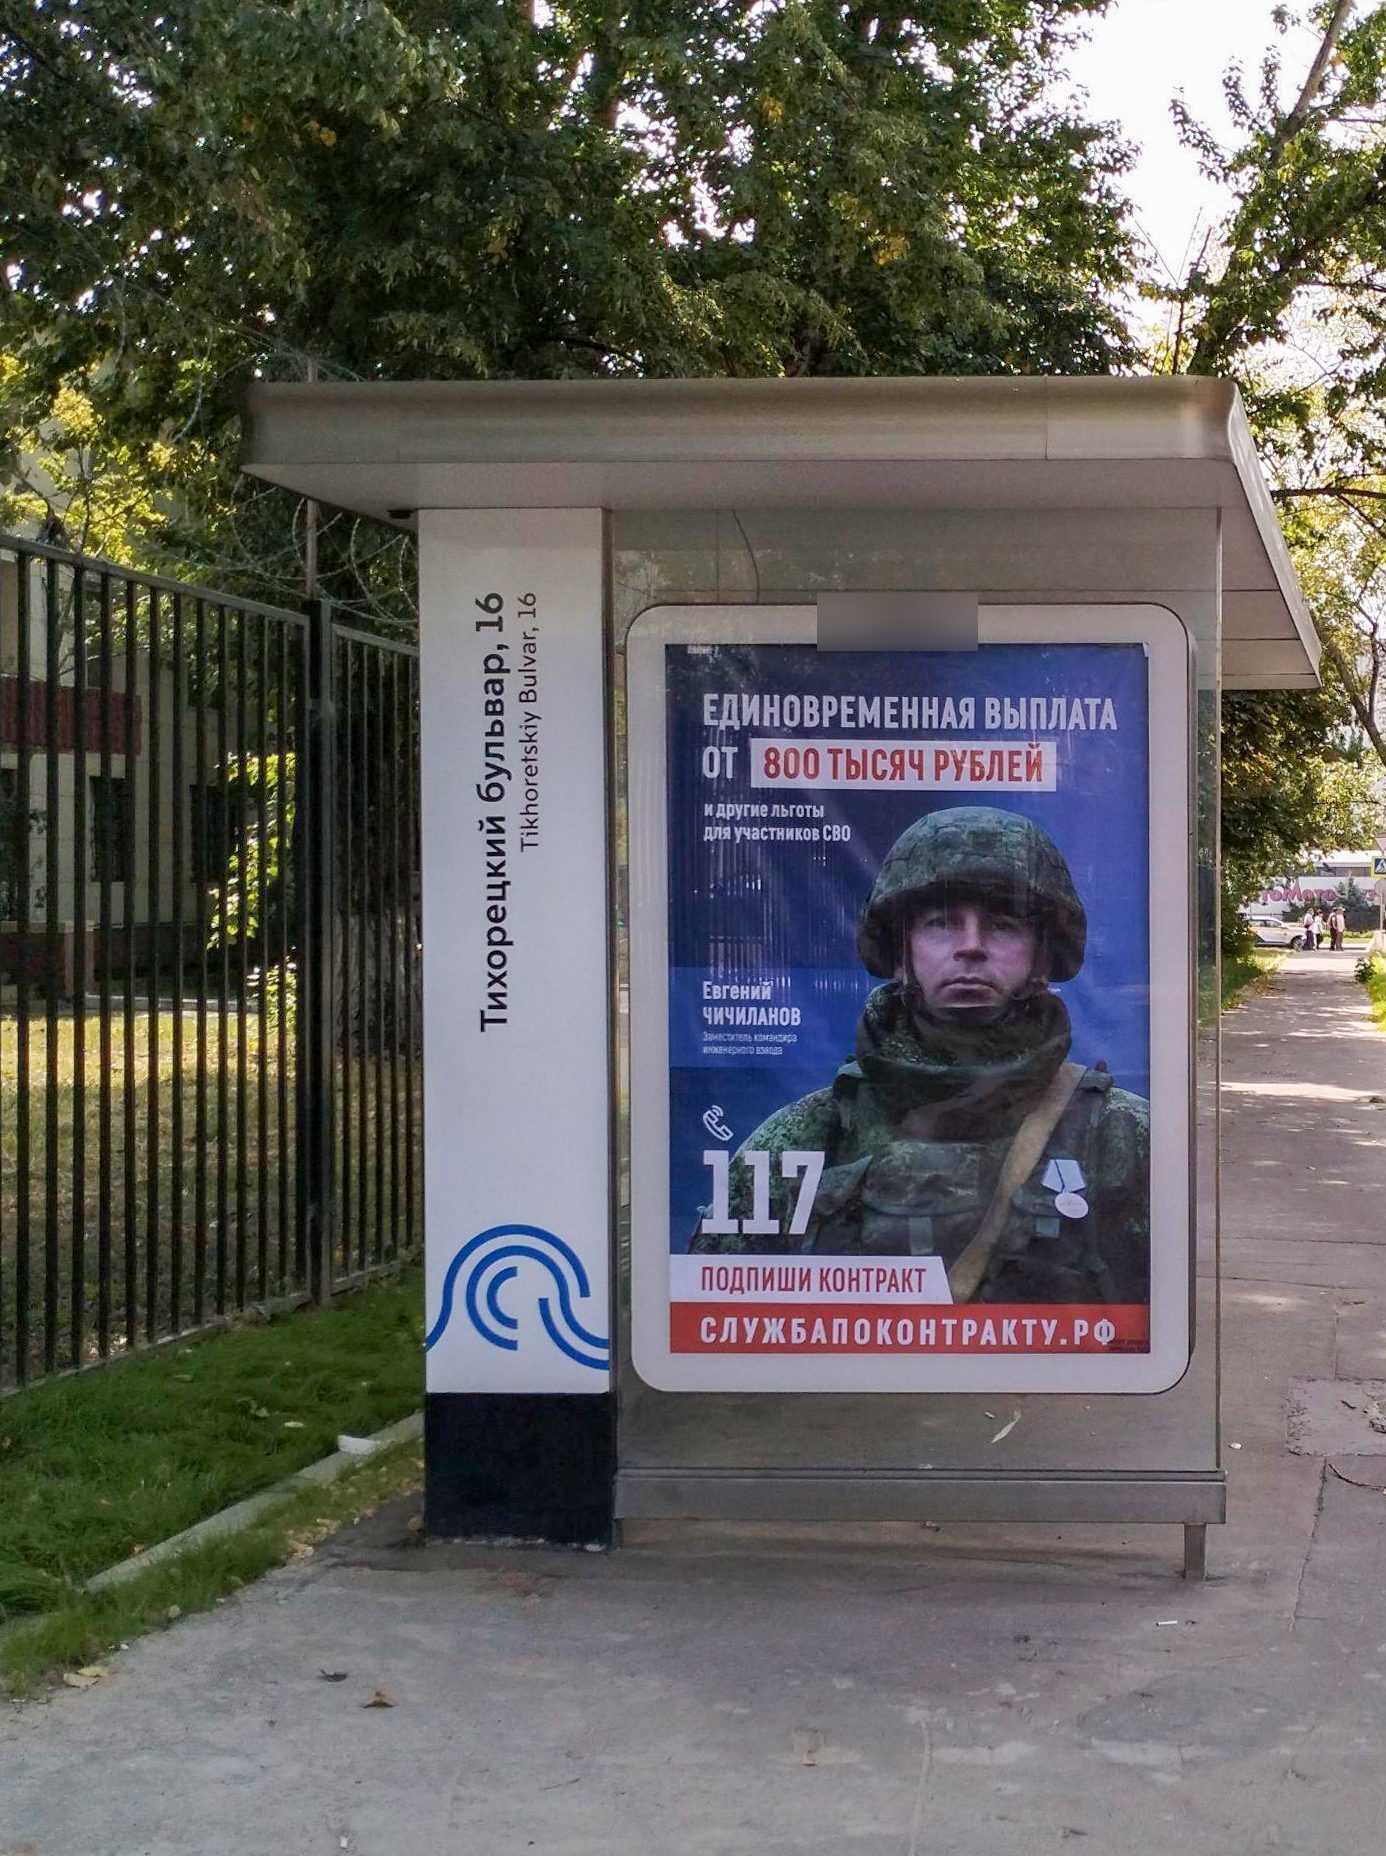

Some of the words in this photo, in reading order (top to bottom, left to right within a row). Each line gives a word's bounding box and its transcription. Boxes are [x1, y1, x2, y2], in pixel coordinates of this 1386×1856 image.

[475, 592, 504, 633] 16
[518, 592, 537, 619] 16
[518, 626, 539, 703] Bulvar,
[476, 643, 512, 802] бульвар,
[703, 693, 975, 731] ЕДИНОВРЕМЕННАЯ
[985, 697, 1118, 731] ВЫПЛАТА
[702, 746, 738, 779] ОТ
[763, 747, 820, 780] 800
[827, 748, 924, 781] ТЫСЯЧ
[934, 742, 1043, 782] РУБЛЕЙ
[518, 711, 543, 852] Tikhoretskiy
[704, 804, 713, 817] и
[716, 803, 768, 820] другие
[771, 804, 824, 818] льготы
[703, 826, 731, 842] для
[733, 826, 820, 844] участников
[822, 825, 851, 842] СВО
[478, 815, 514, 1033] Тихорецкий
[703, 980, 771, 1000] Евгений
[703, 1006, 802, 1026] ЧИЧИЛАНОВ
[702, 1149, 825, 1235] 117
[701, 1266, 812, 1294] ПОДПИШИ
[819, 1267, 927, 1294] КОНТРАКТ
[700, 1317, 1116, 1346] СЛУЖБАПОКОНТРАКТУ.РФ
